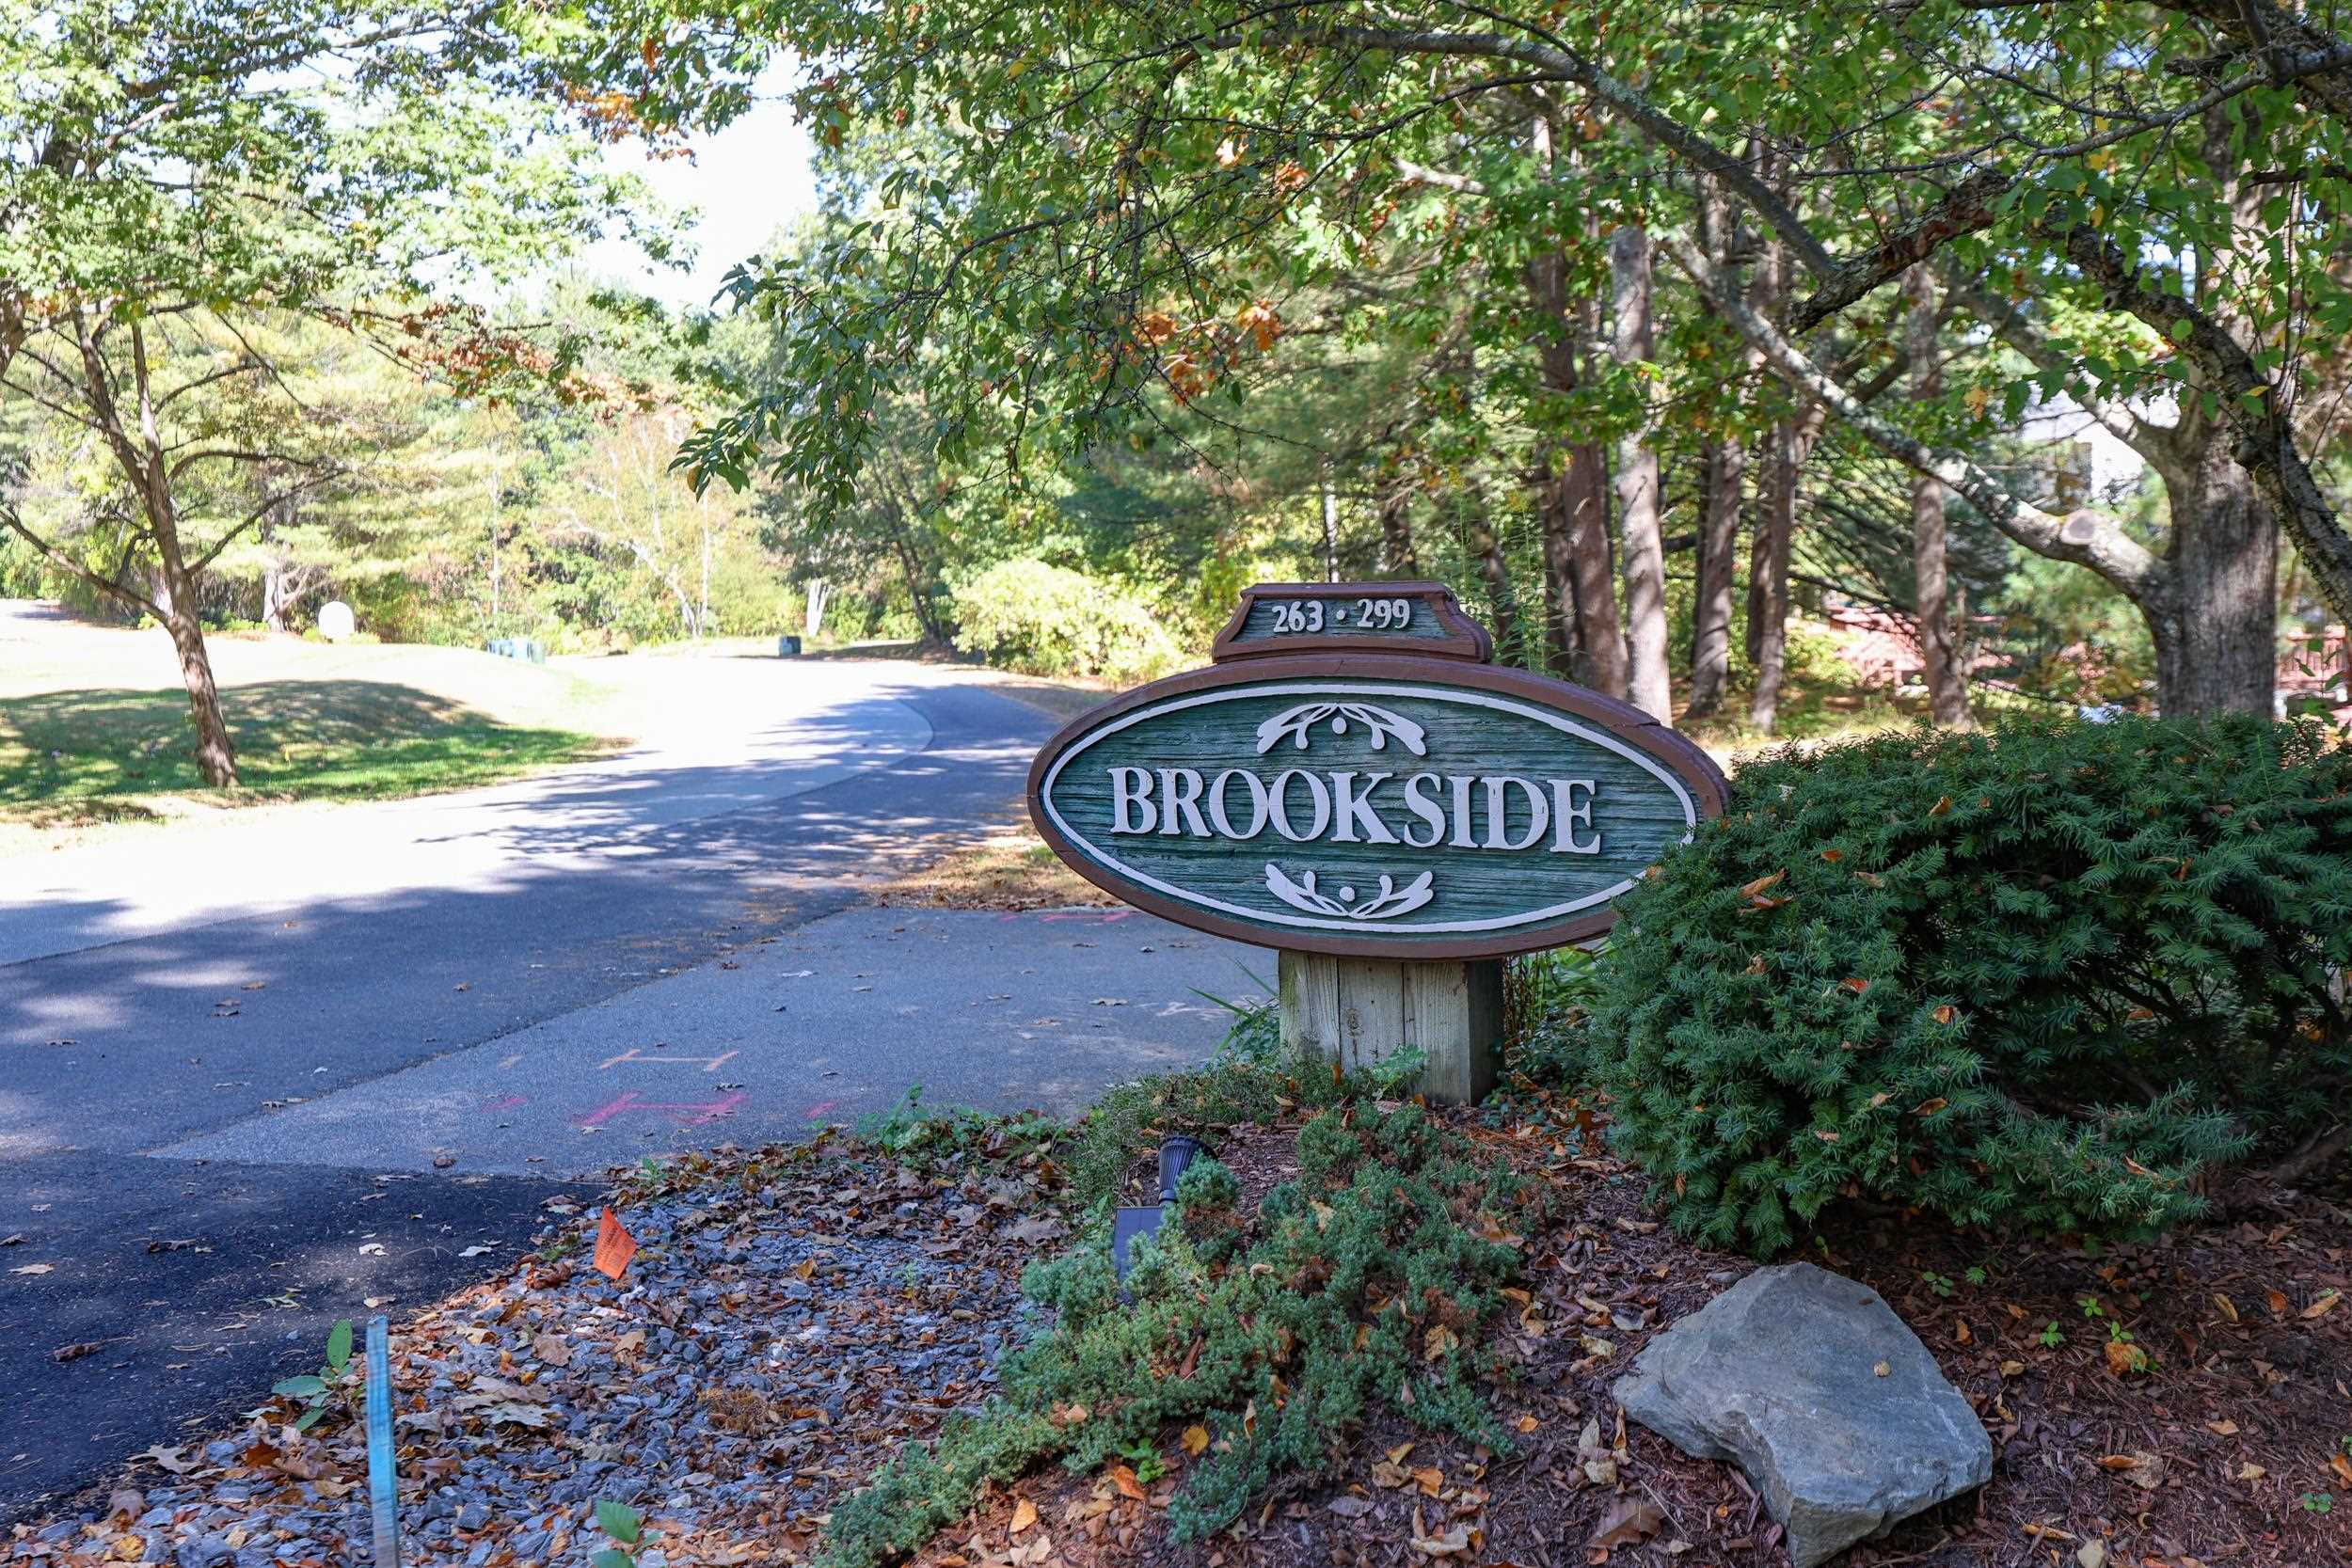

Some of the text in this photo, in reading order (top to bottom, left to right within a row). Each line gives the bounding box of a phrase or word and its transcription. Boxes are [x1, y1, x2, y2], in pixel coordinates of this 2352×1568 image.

[1272, 598, 1410, 633] 263 299
[1107, 767, 1601, 854] BROOKSIDE
